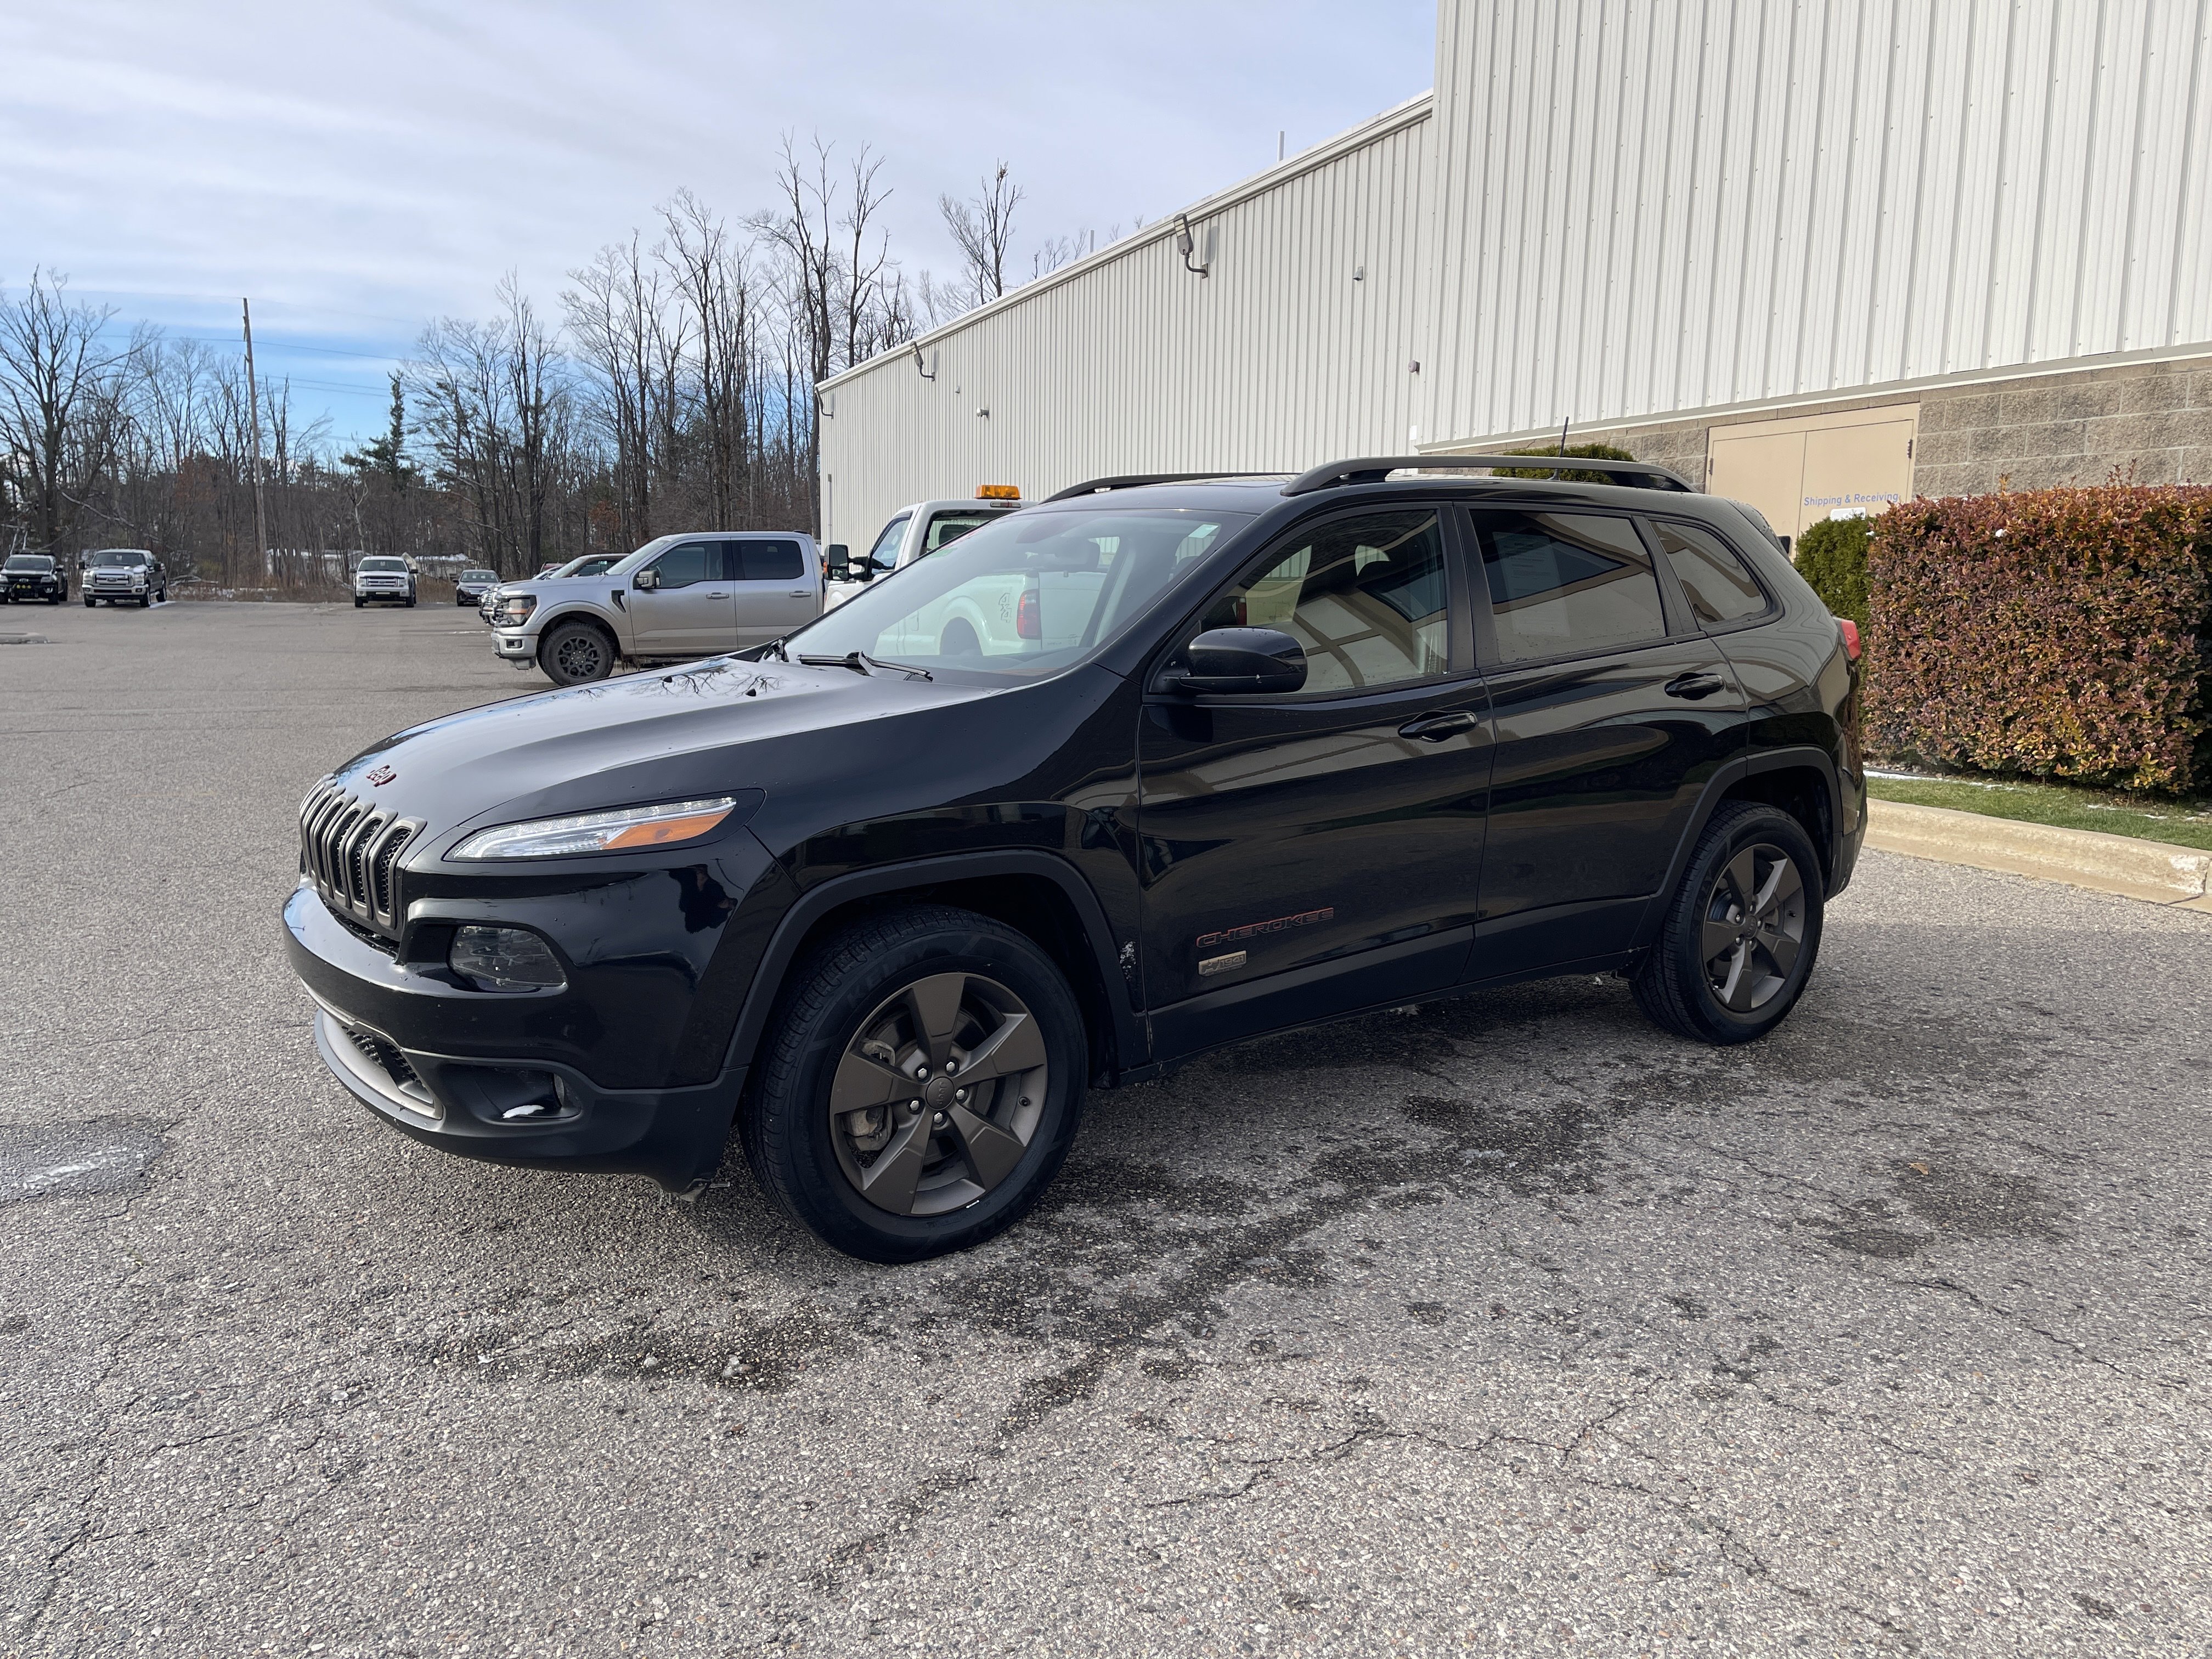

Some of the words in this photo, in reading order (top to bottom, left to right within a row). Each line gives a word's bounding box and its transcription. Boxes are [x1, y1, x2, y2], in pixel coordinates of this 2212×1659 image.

[1804, 496, 1842, 507] Shipping
[1845, 494, 1851, 503] &
[1854, 493, 1898, 503] Receiving
[366, 764, 397, 787] Jeep
[1196, 907, 1334, 949] CHEROKEE
[1220, 955, 1244, 967] 1941
